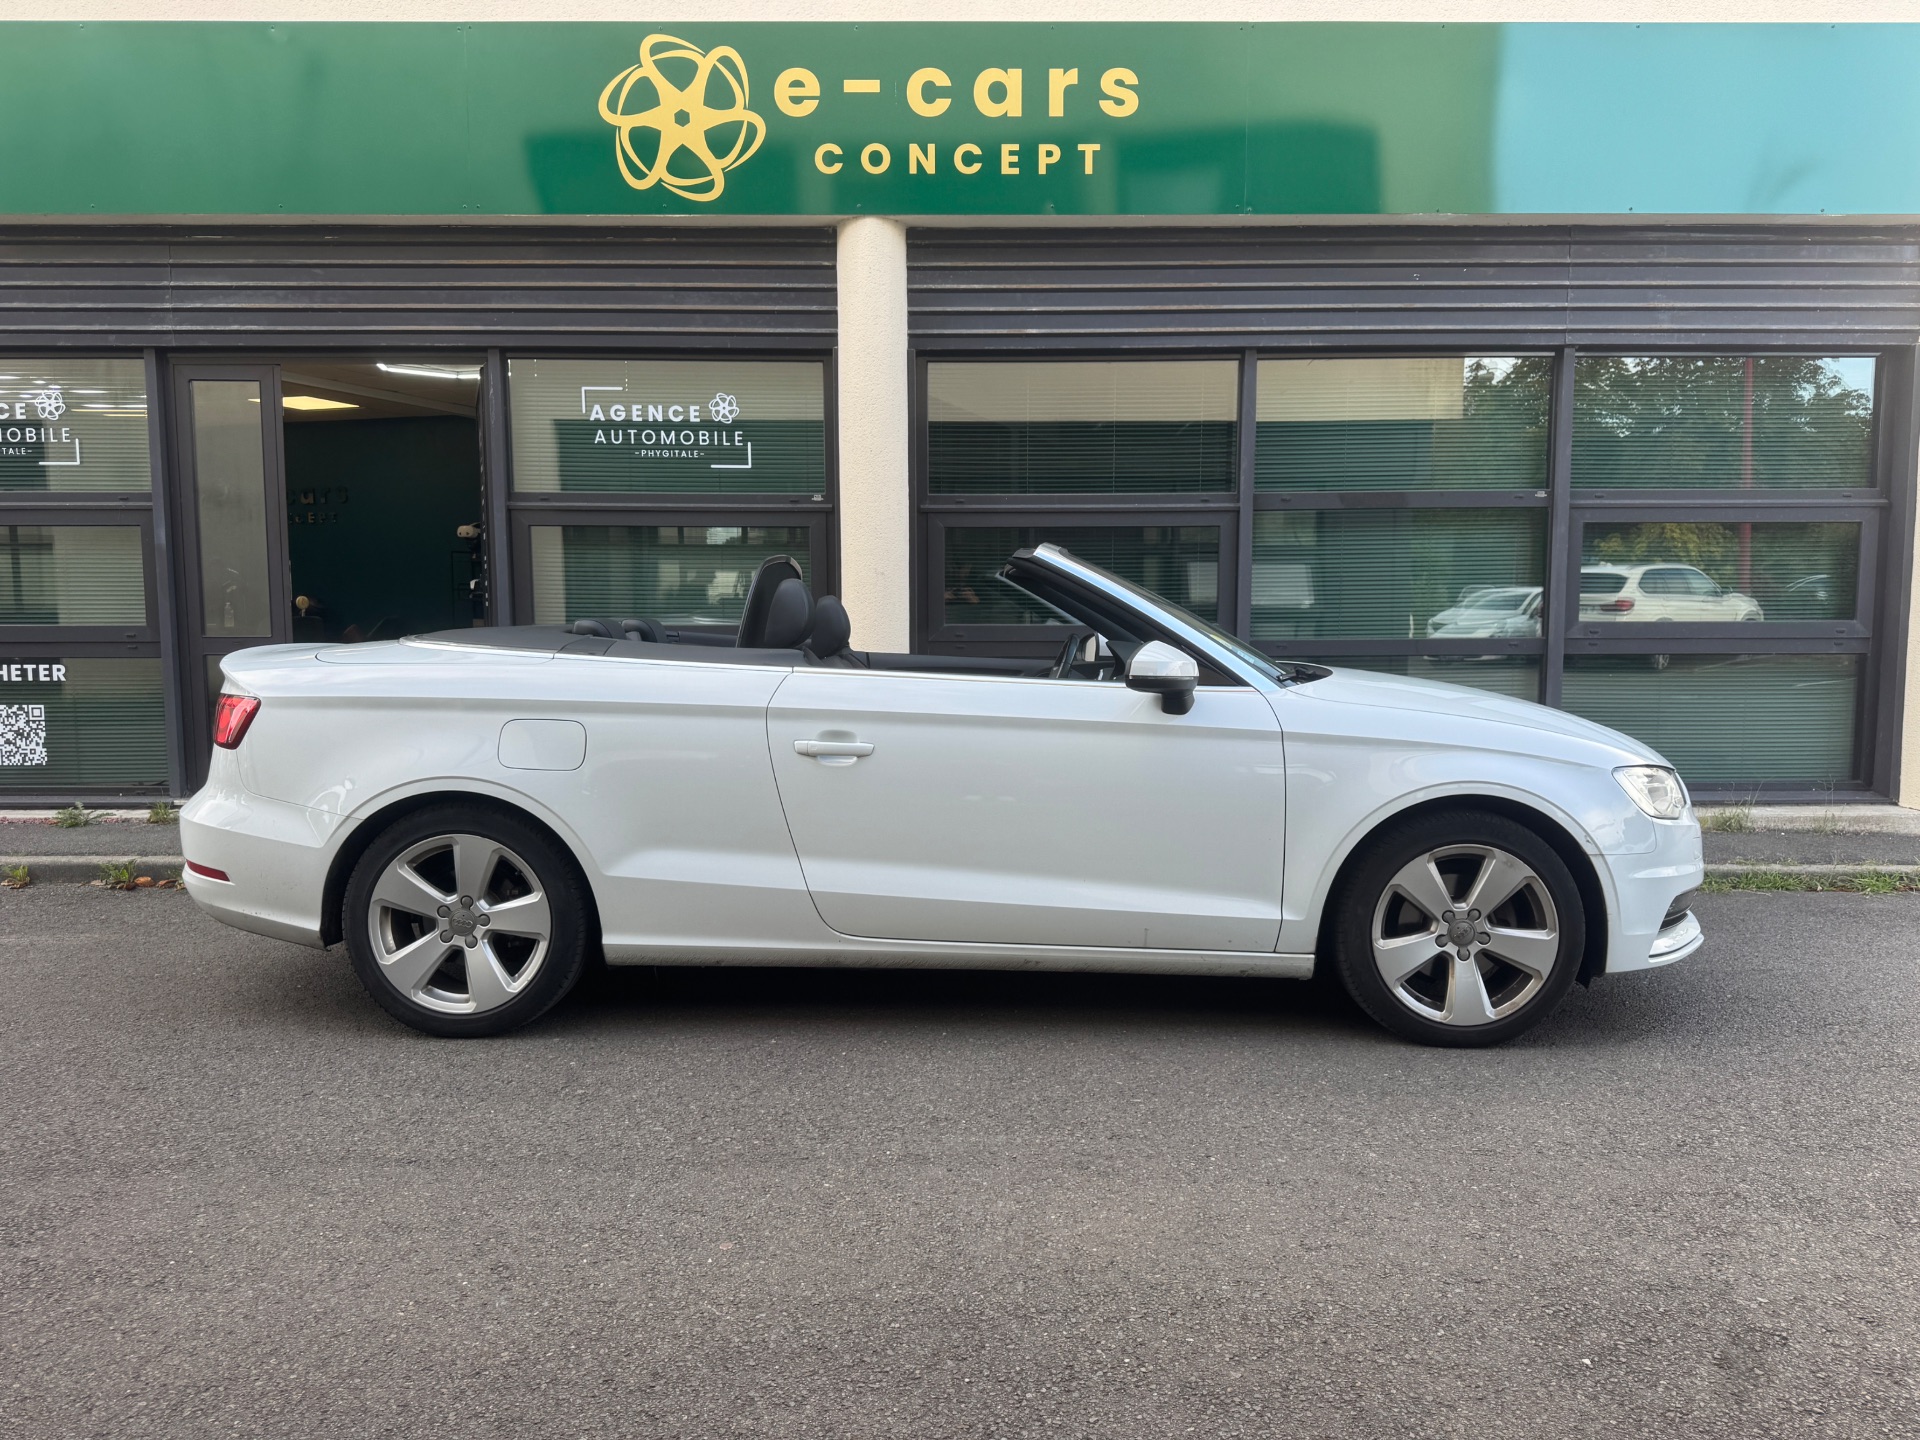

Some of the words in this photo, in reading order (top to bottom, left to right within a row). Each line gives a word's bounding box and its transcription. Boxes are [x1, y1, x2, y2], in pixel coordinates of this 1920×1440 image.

[814, 142, 1101, 175] CONCEPT
[589, 404, 701, 422] AGENCE
[594, 429, 743, 446] AUTOMOBILE
